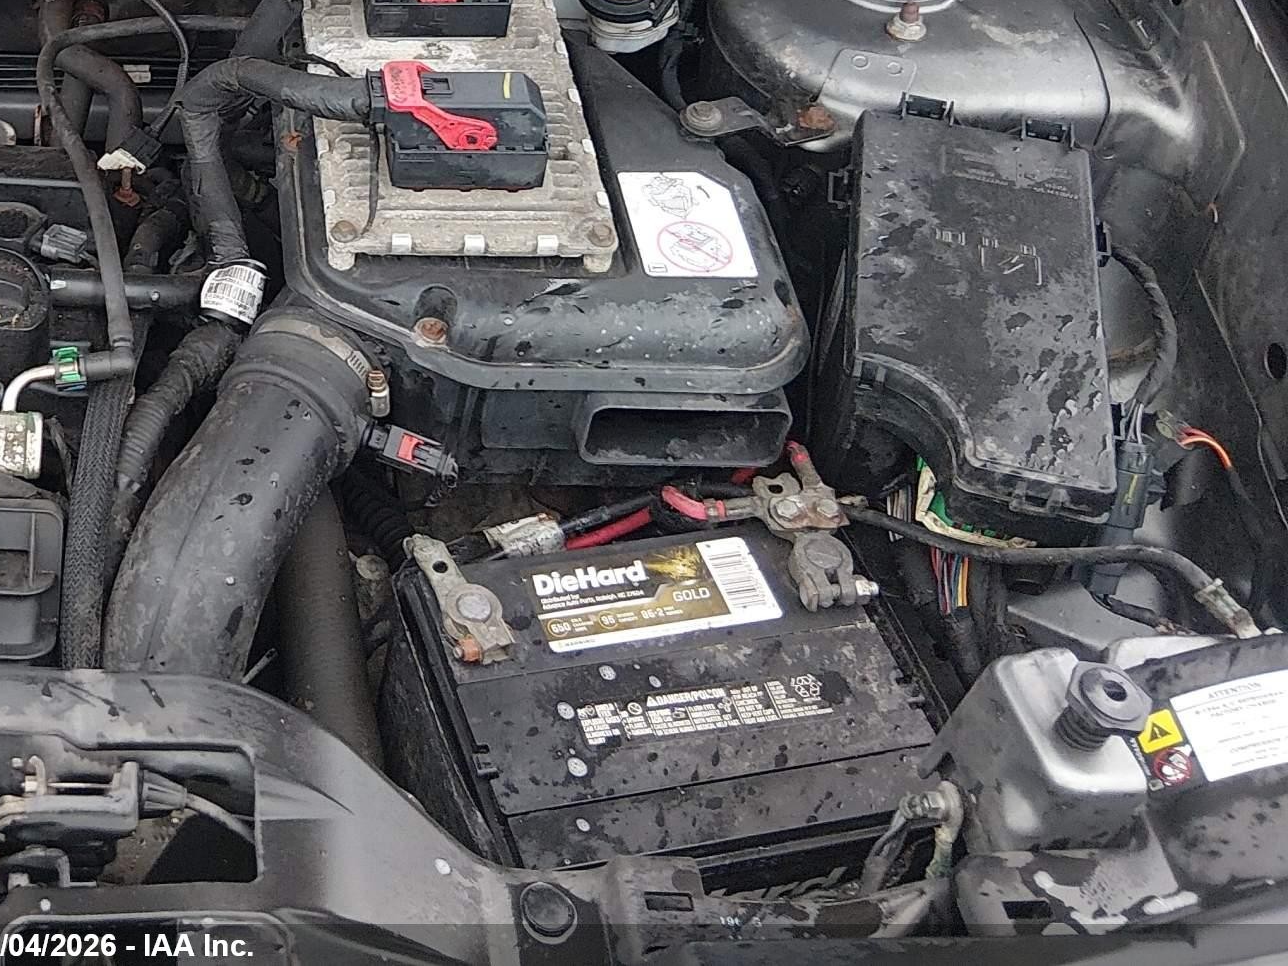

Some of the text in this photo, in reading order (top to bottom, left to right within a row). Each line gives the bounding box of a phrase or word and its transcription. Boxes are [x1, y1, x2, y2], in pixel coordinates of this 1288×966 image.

[532, 560, 648, 596] DieHard
[672, 587, 711, 602] GOLD
[601, 615, 615, 625] 95
[550, 622, 570, 633] 650
